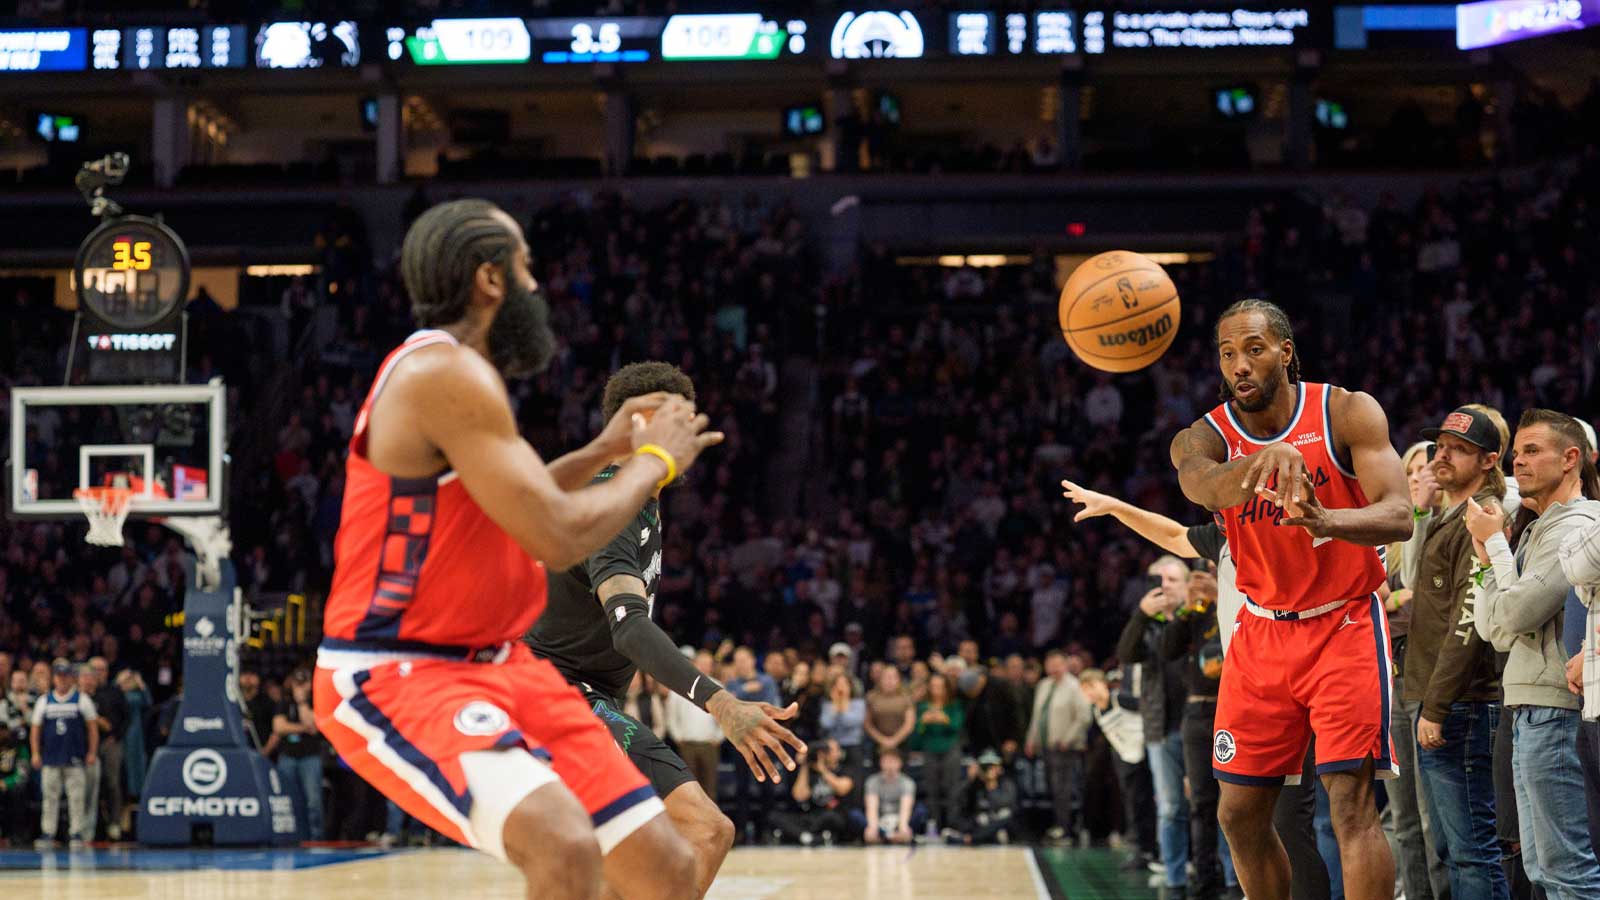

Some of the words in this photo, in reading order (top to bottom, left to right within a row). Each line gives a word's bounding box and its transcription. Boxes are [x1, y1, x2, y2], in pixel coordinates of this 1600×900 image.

[571, 23, 621, 54] 3.5
[112, 242, 152, 270] 3.5
[1098, 313, 1172, 346] Wilson
[111, 333, 176, 351] TISSOT
[1292, 435, 1323, 446] RWANDA
[1297, 431, 1316, 440] VISIT
[148, 797, 260, 817] CFMOTO
